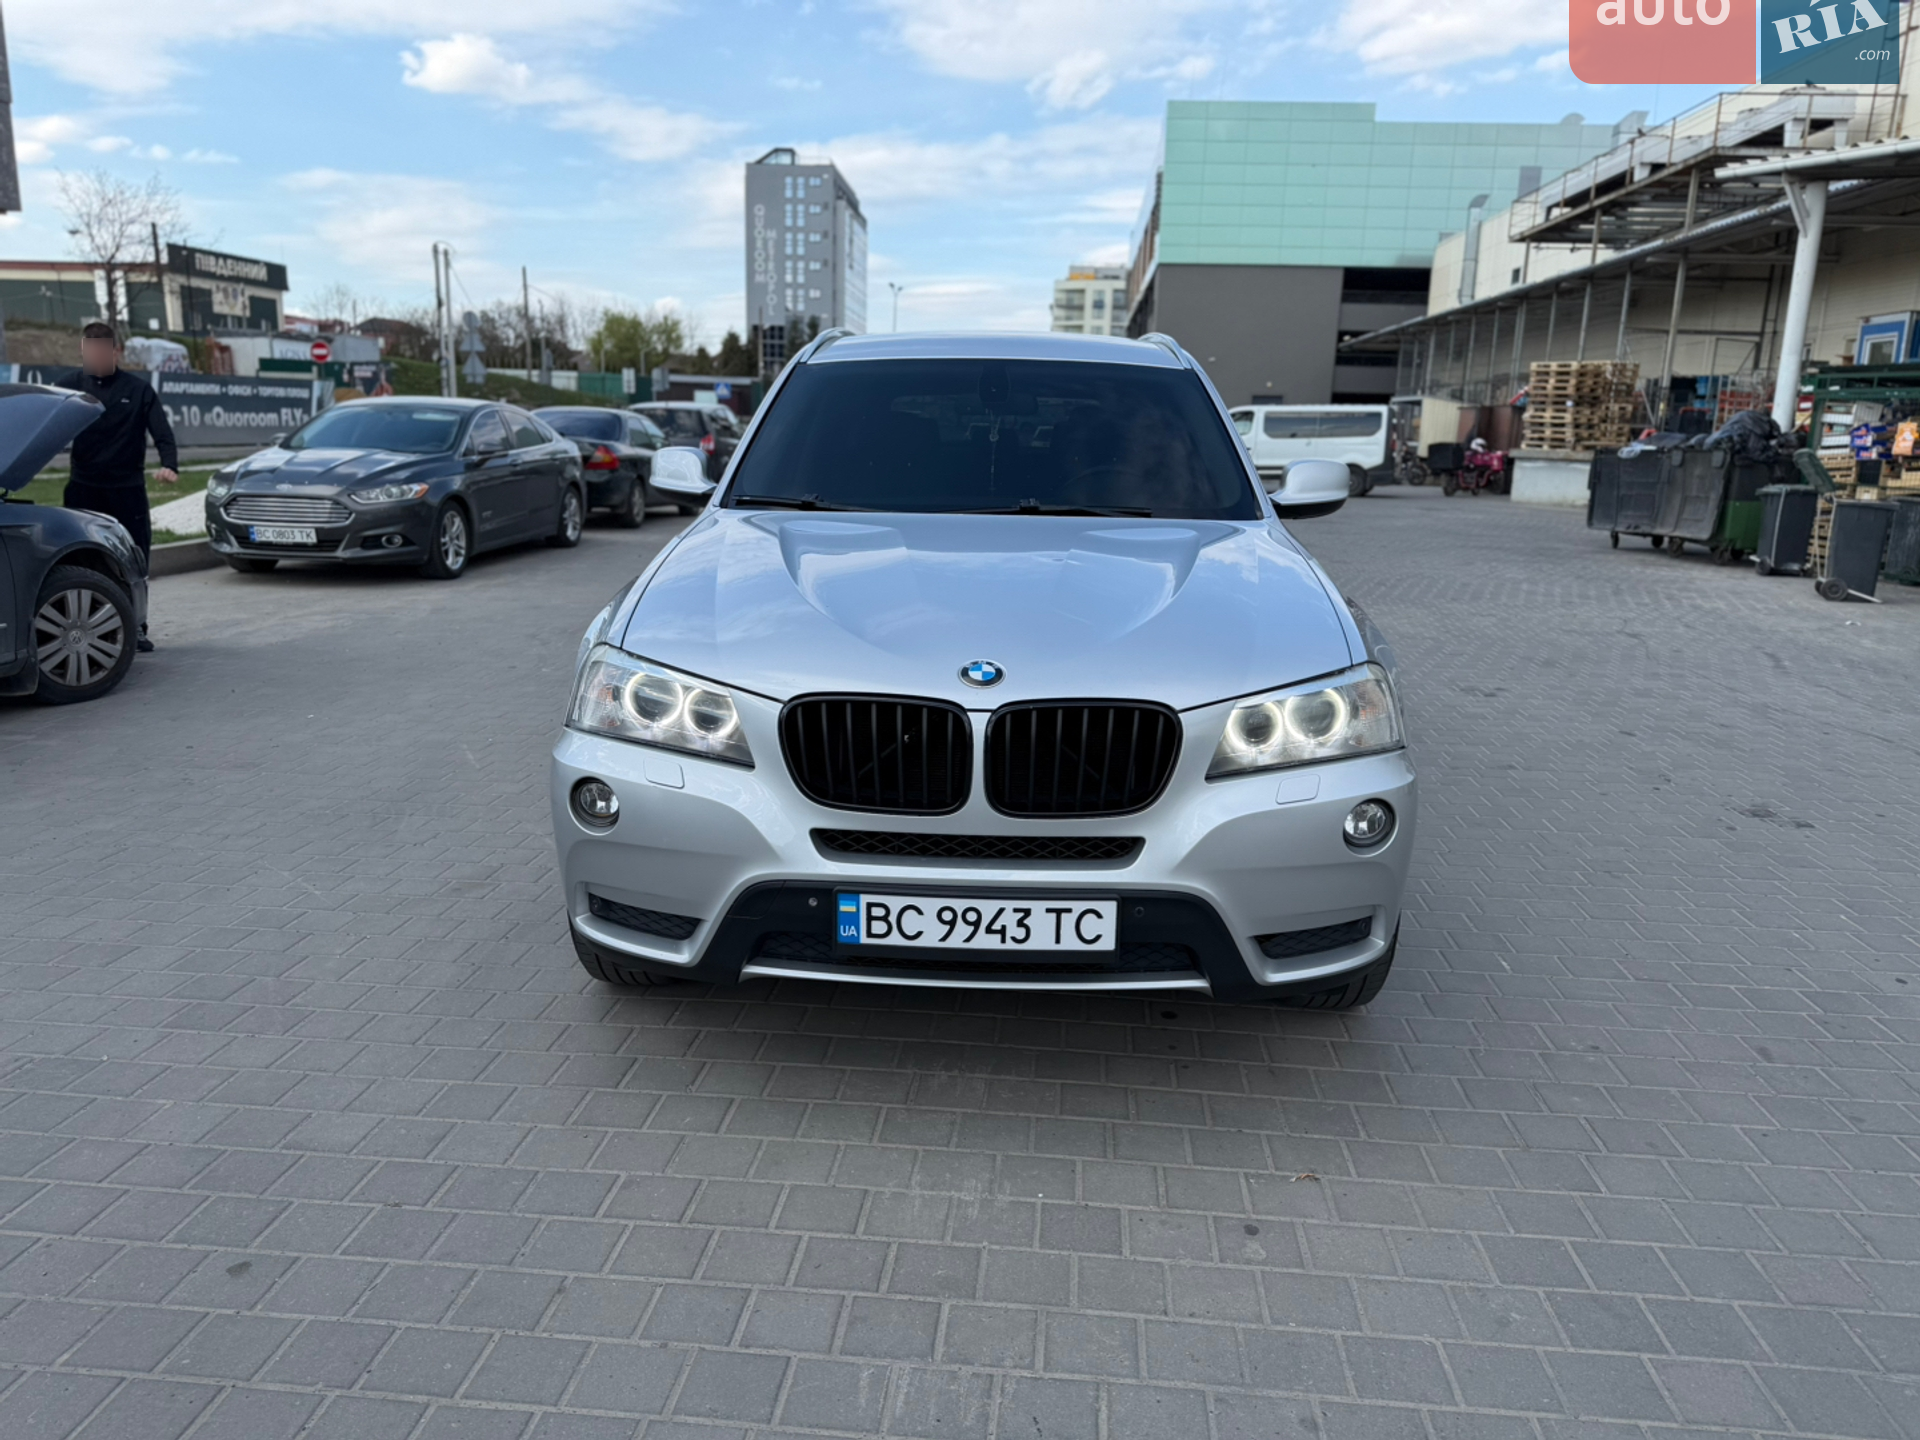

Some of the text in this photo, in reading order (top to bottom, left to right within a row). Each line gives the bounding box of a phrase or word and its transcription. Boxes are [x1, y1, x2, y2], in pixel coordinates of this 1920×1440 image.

[194, 252, 269, 282] ПІВДЕННИЙ
[256, 528, 271, 540] BC
[297, 530, 315, 541] TK
[840, 925, 858, 937] UA
[865, 901, 1104, 945] BC 9943 TC
